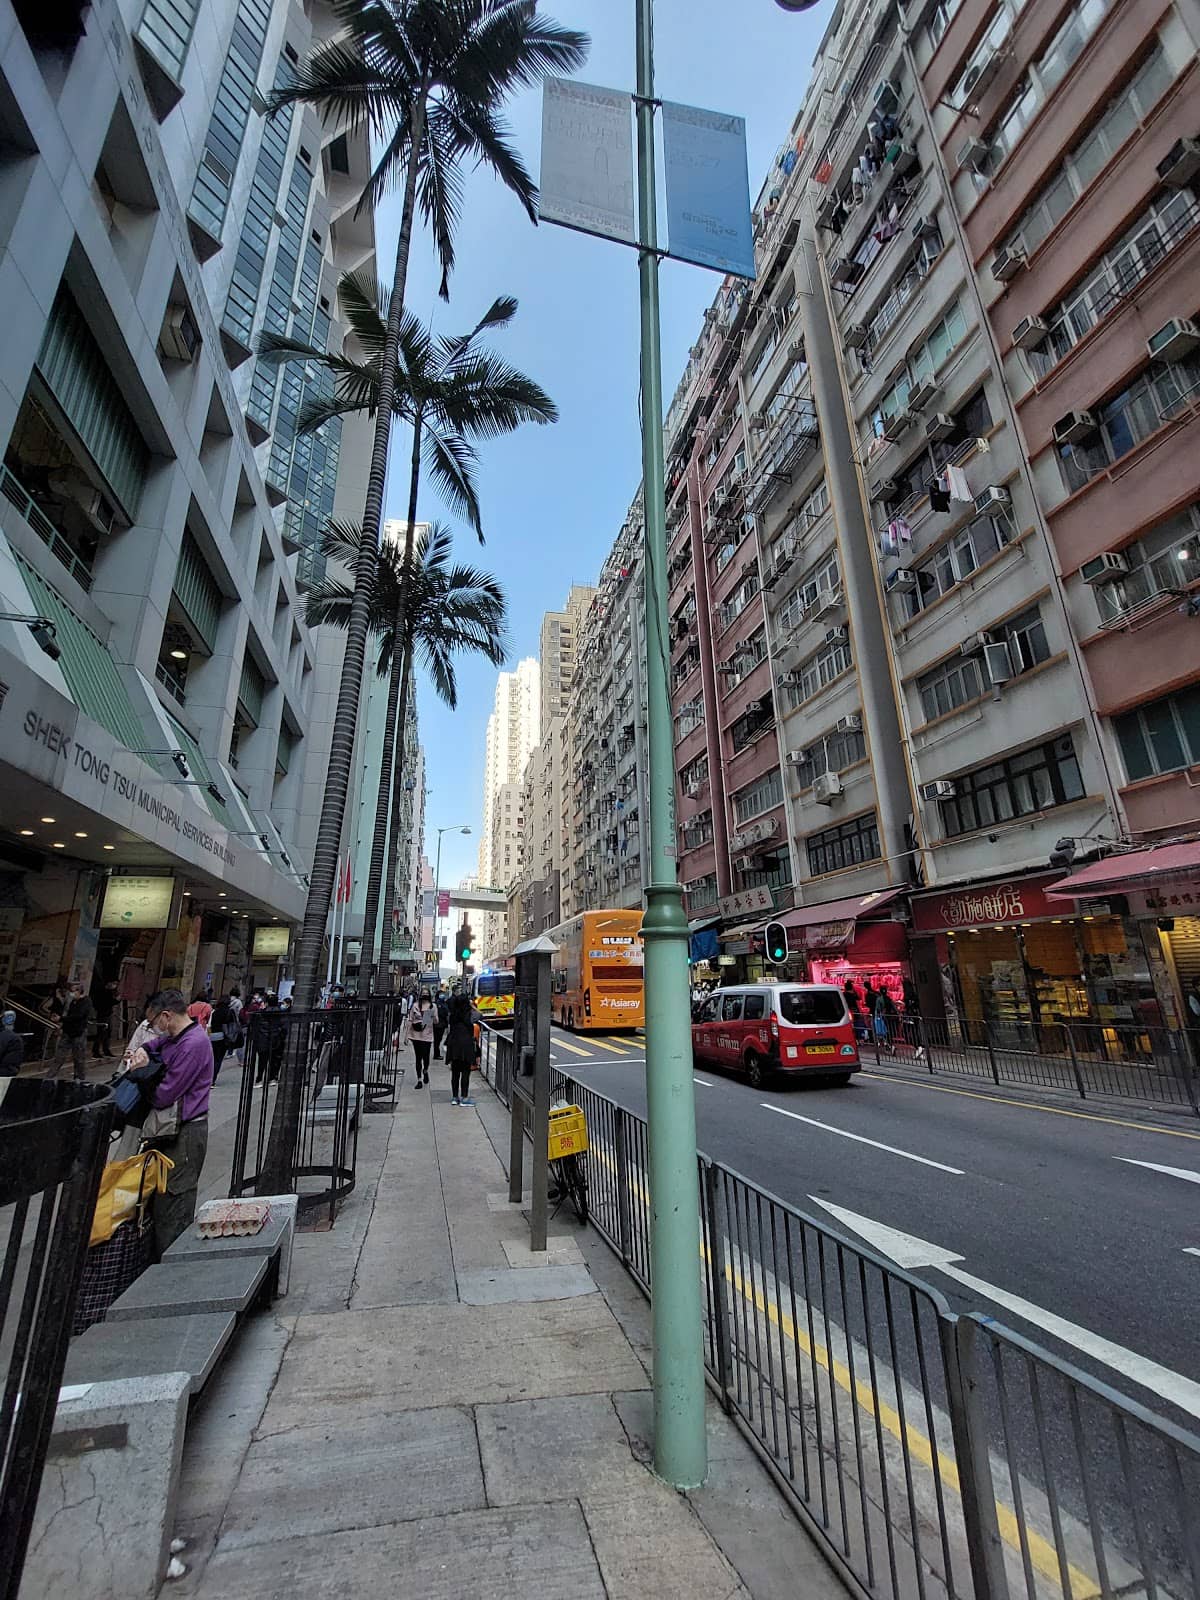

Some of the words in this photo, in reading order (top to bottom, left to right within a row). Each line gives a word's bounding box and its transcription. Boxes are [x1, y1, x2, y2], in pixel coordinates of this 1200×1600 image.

[23, 711, 71, 760] SHEK
[73, 743, 110, 785] TONG
[113, 770, 137, 802] TSUI
[138, 789, 181, 833] MUNICIPAL
[182, 820, 214, 853] SERVICES
[610, 998, 640, 1009] Asiaray
